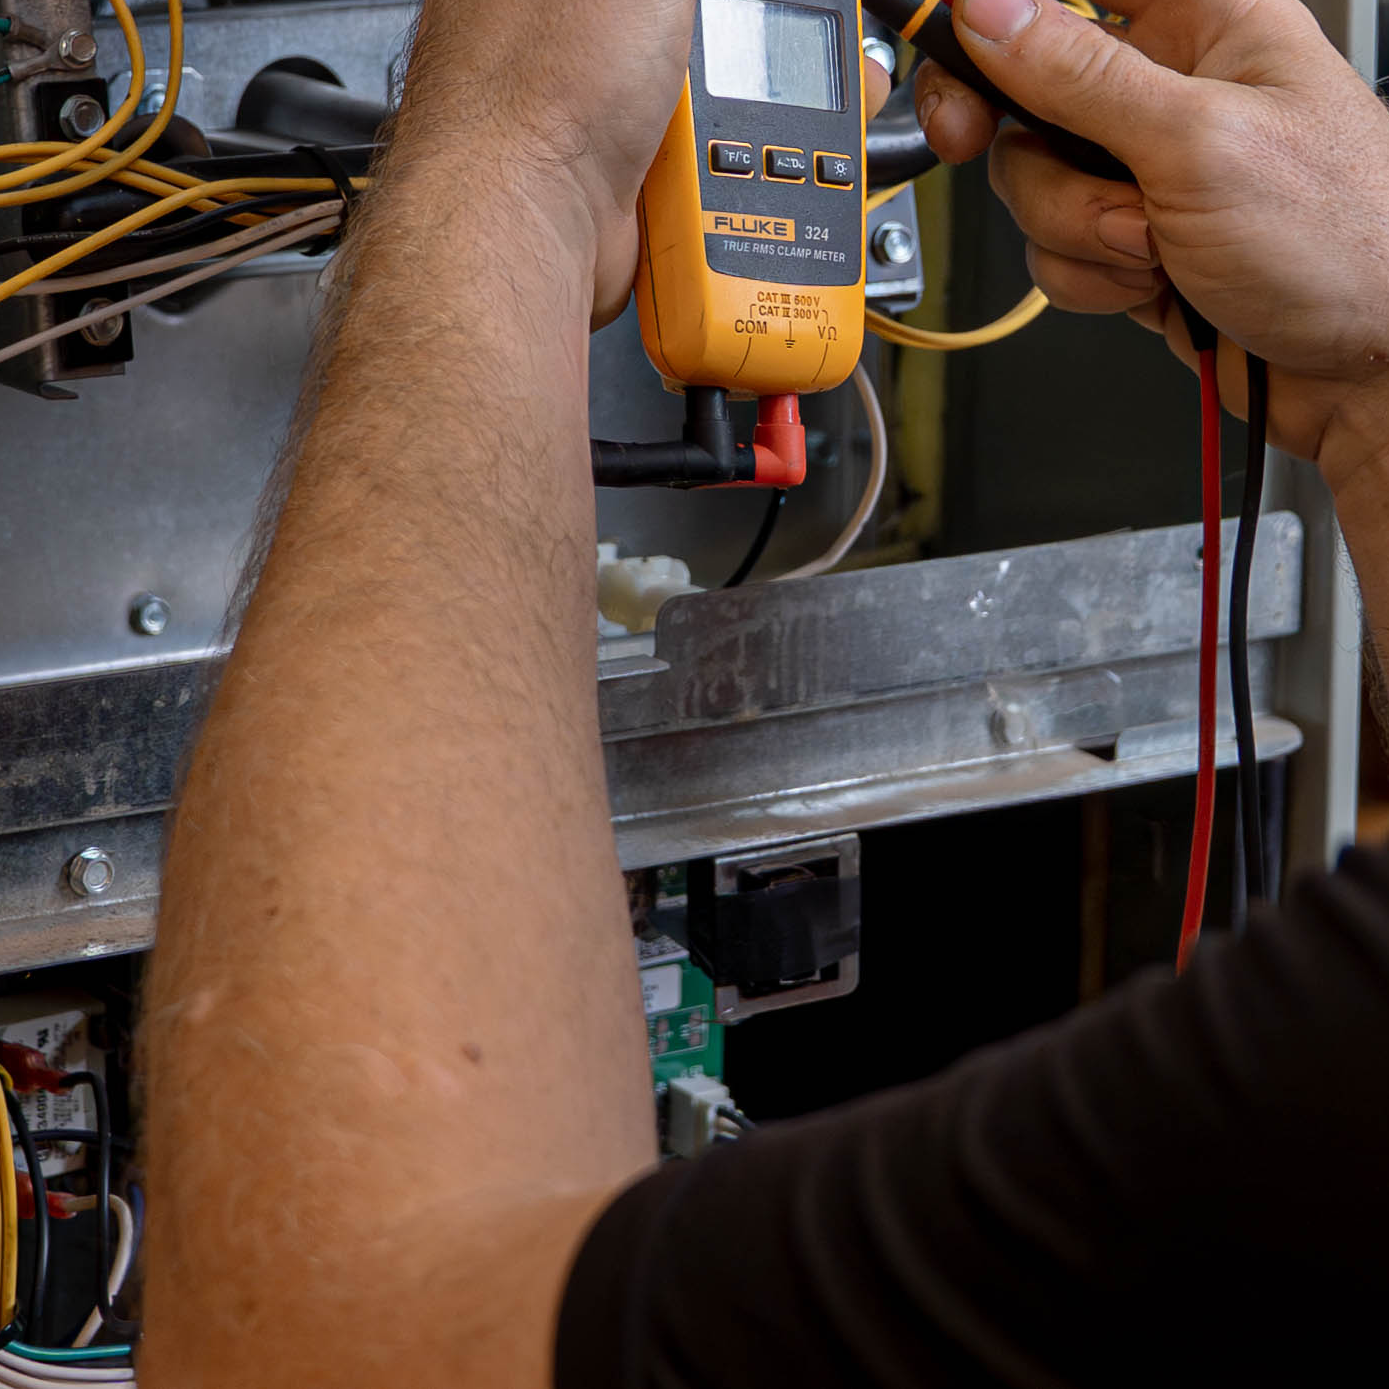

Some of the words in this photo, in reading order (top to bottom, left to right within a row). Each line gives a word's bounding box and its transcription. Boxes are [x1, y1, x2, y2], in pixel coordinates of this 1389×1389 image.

[714, 216, 788, 237] FLUKE
[804, 225, 830, 242] 324
[723, 239, 750, 253] TRUE
[752, 242, 775, 256] RMS
[777, 245, 812, 259] CLAMP
[813, 248, 846, 263] METER
[757, 291, 779, 304] CAT
[758, 305, 780, 317] CAT
[734, 319, 768, 335] COM
